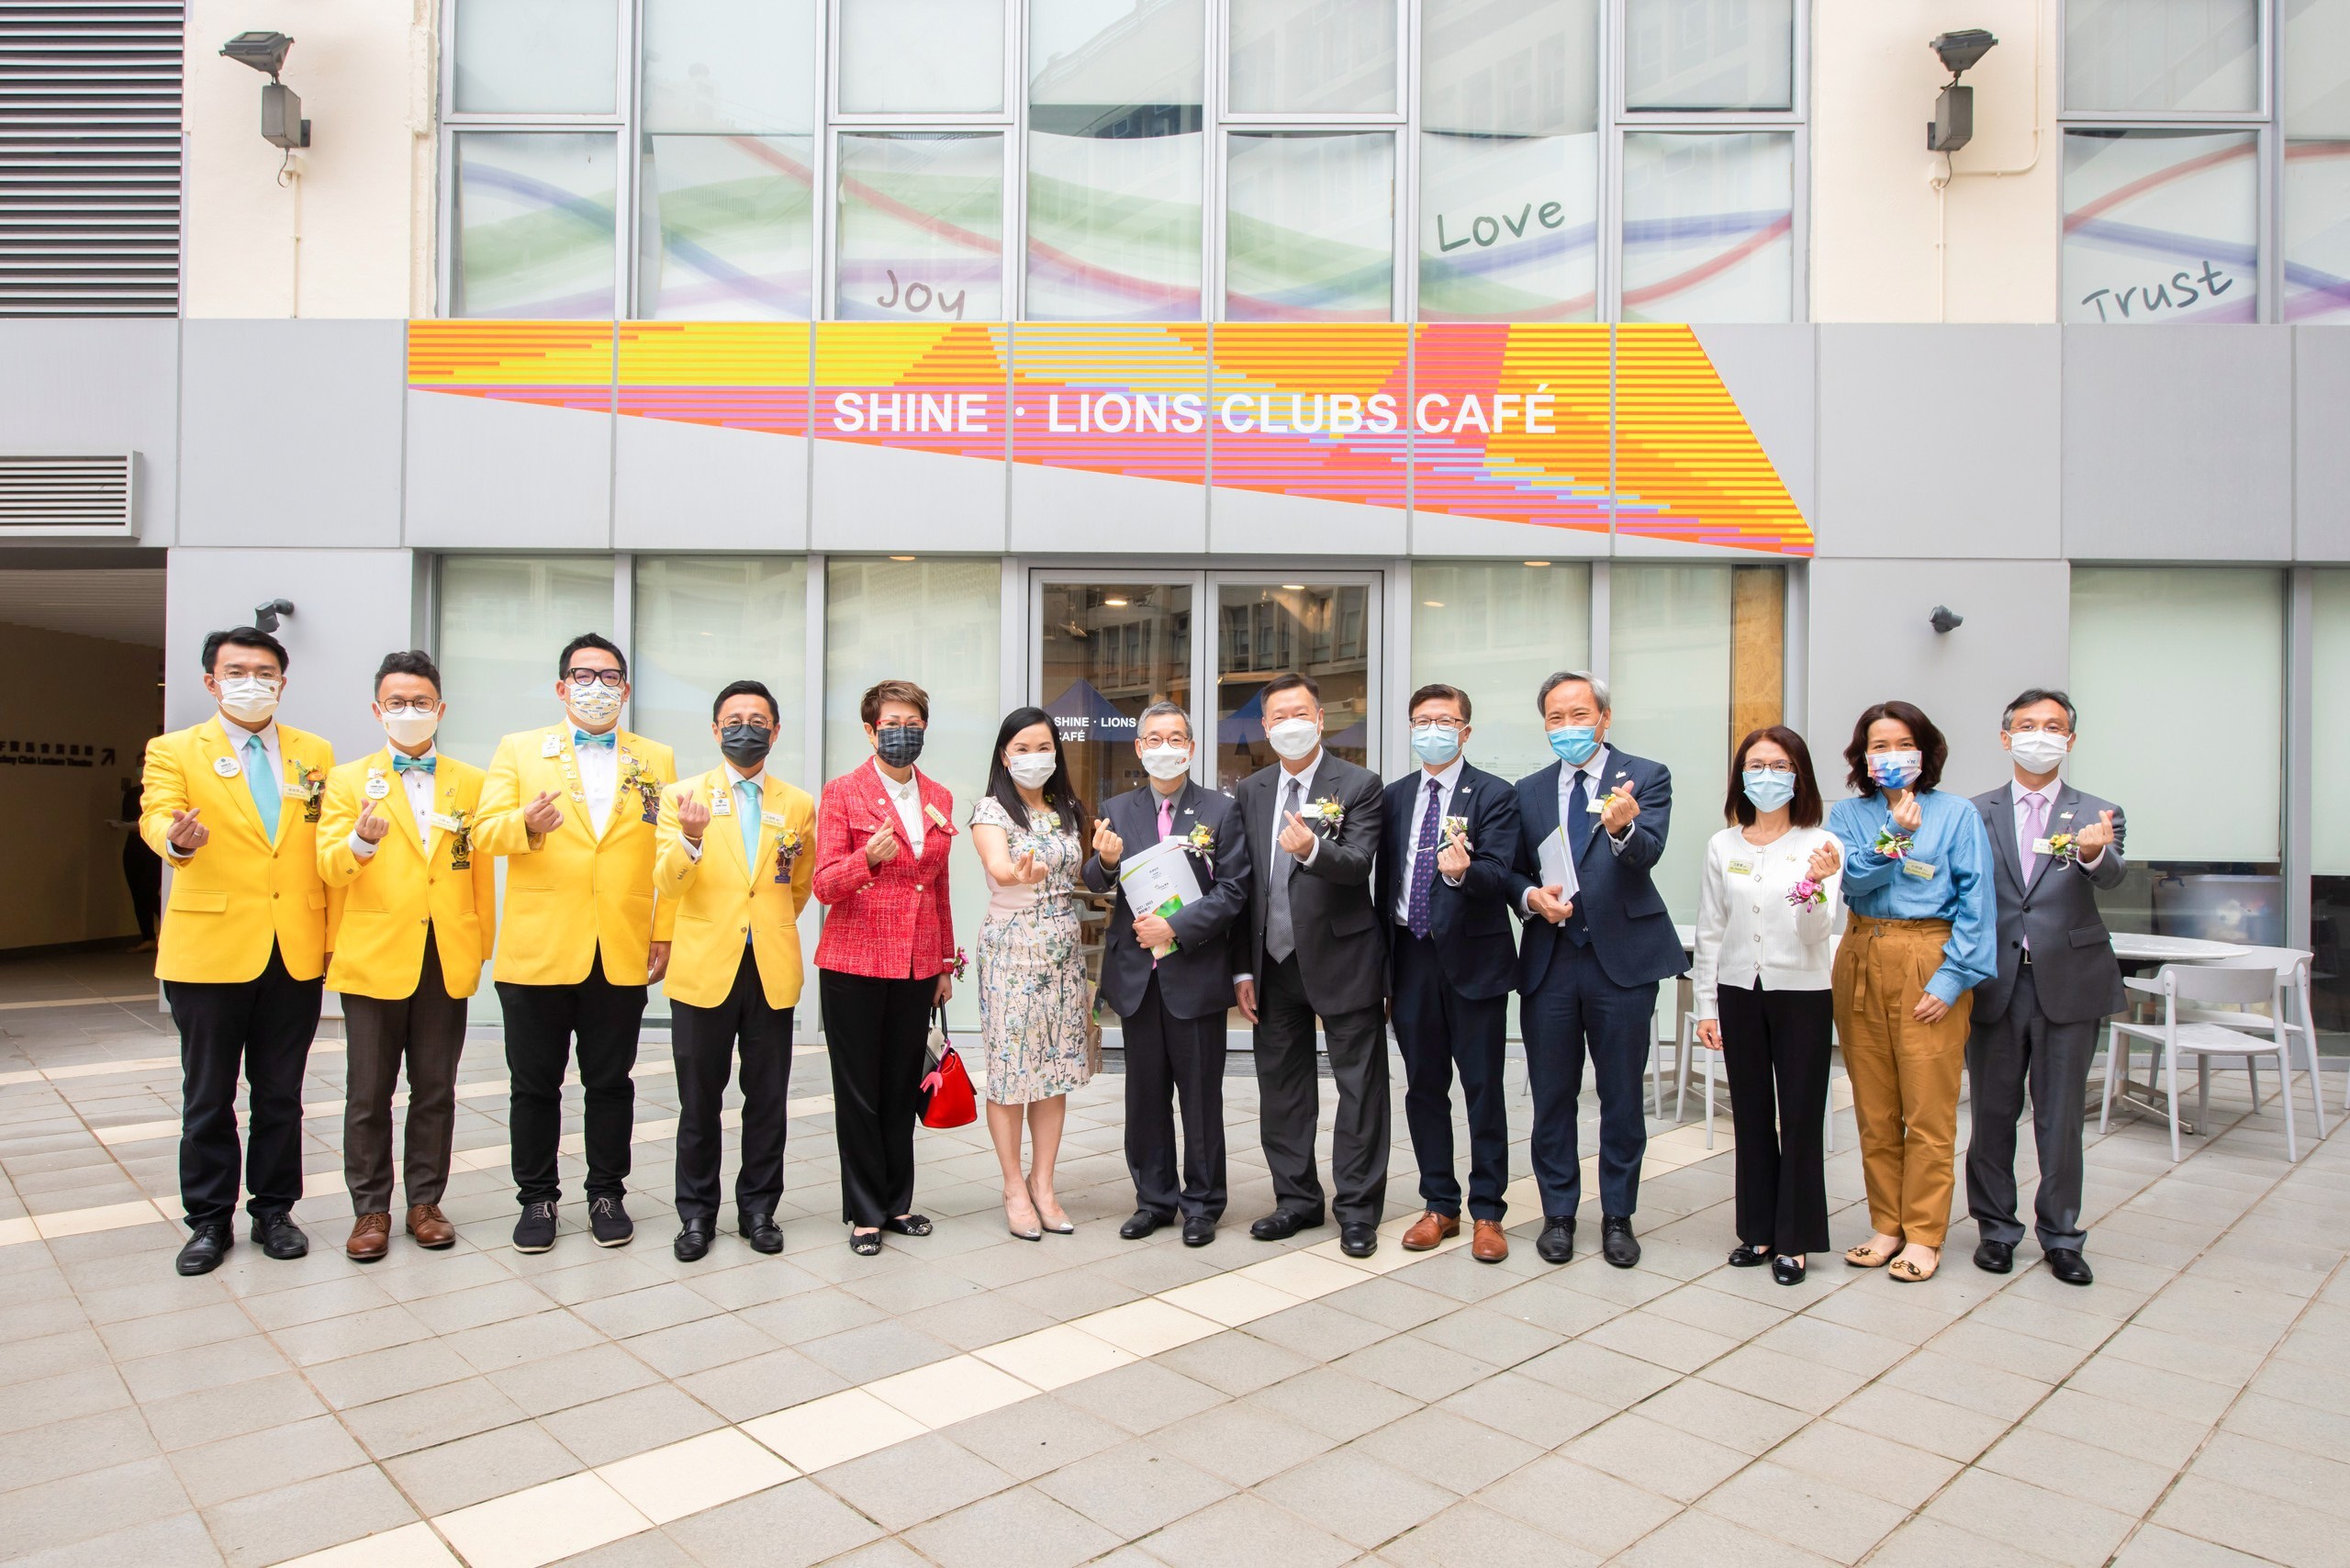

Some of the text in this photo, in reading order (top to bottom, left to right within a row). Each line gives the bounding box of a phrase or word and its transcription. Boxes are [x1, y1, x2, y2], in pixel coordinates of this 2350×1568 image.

[1437, 201, 1565, 252] Love
[2081, 261, 2232, 323] Trust
[833, 392, 989, 433] SHINE
[1048, 393, 1203, 433] LIONS
[1220, 393, 1399, 434] CLUBS
[1415, 383, 1557, 434] CAFÉ
[1054, 716, 1090, 727] SHINE
[1101, 717, 1137, 728] LIONS
